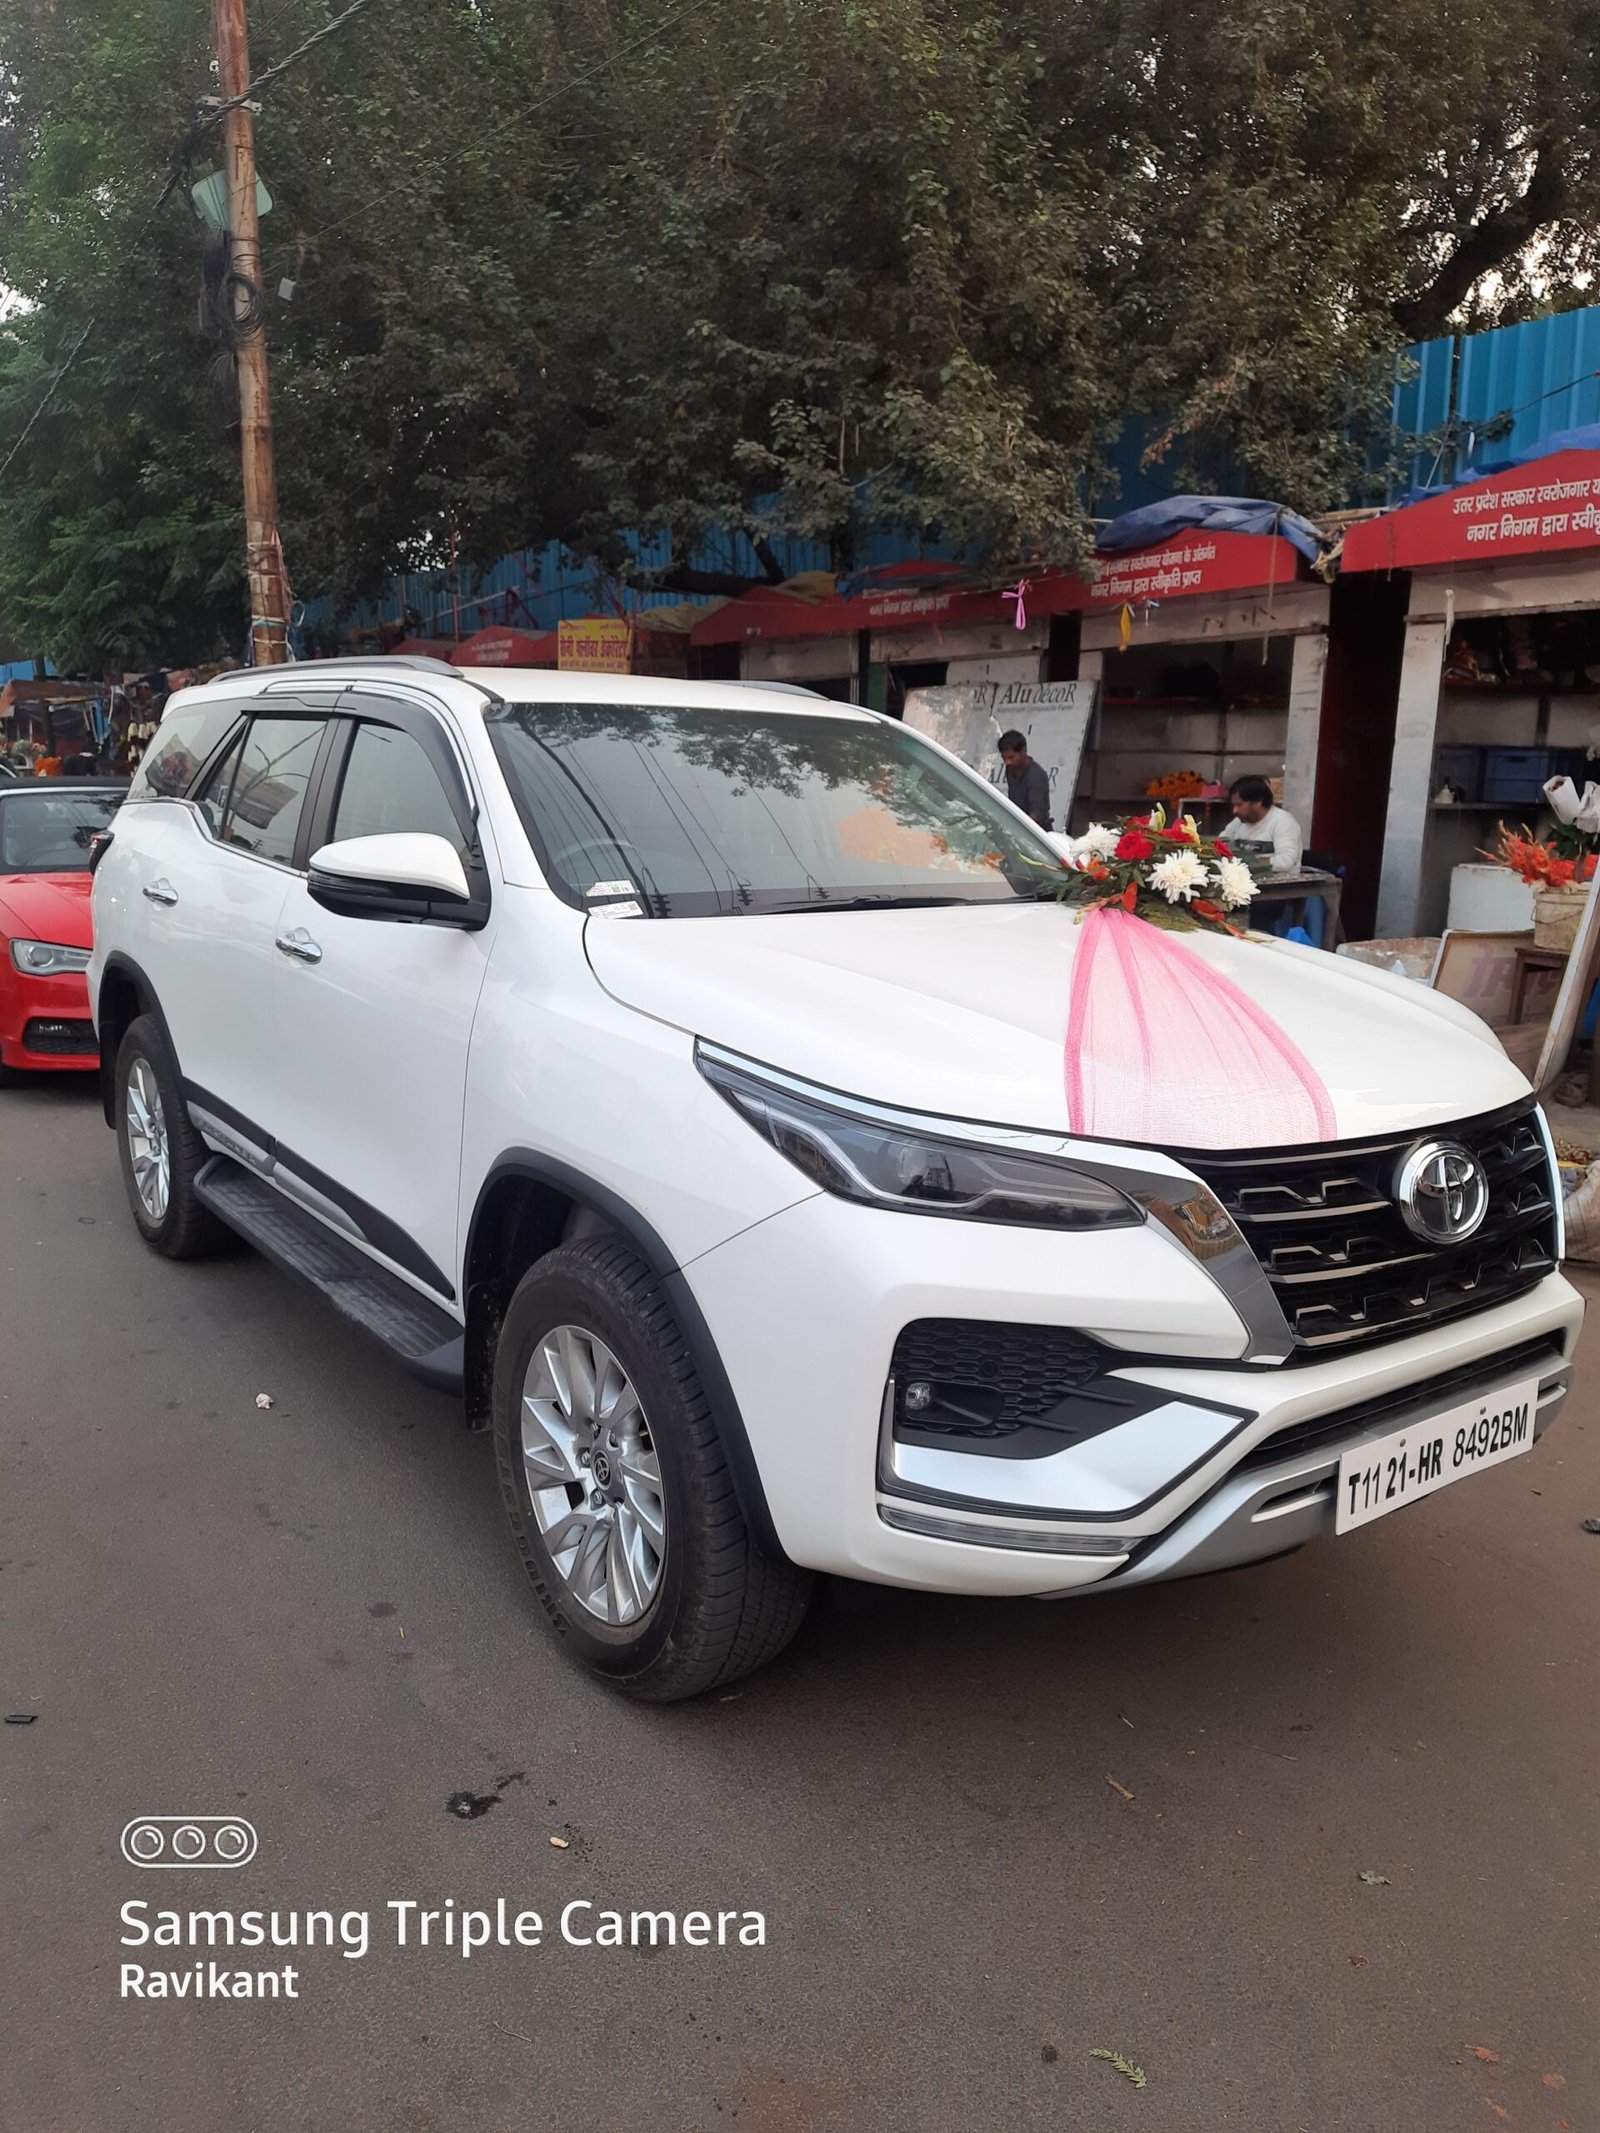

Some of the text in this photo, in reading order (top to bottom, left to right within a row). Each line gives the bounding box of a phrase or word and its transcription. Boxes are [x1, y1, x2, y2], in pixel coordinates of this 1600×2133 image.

[1475, 488, 1499, 514] प्रदेश
[1501, 487, 1537, 508] सरकार
[1467, 522, 1499, 541] नगर
[1500, 513, 1539, 539] निगम
[1541, 513, 1569, 536] द्वारा
[1349, 1402, 1529, 1515] T11 21-HR 8492BM
